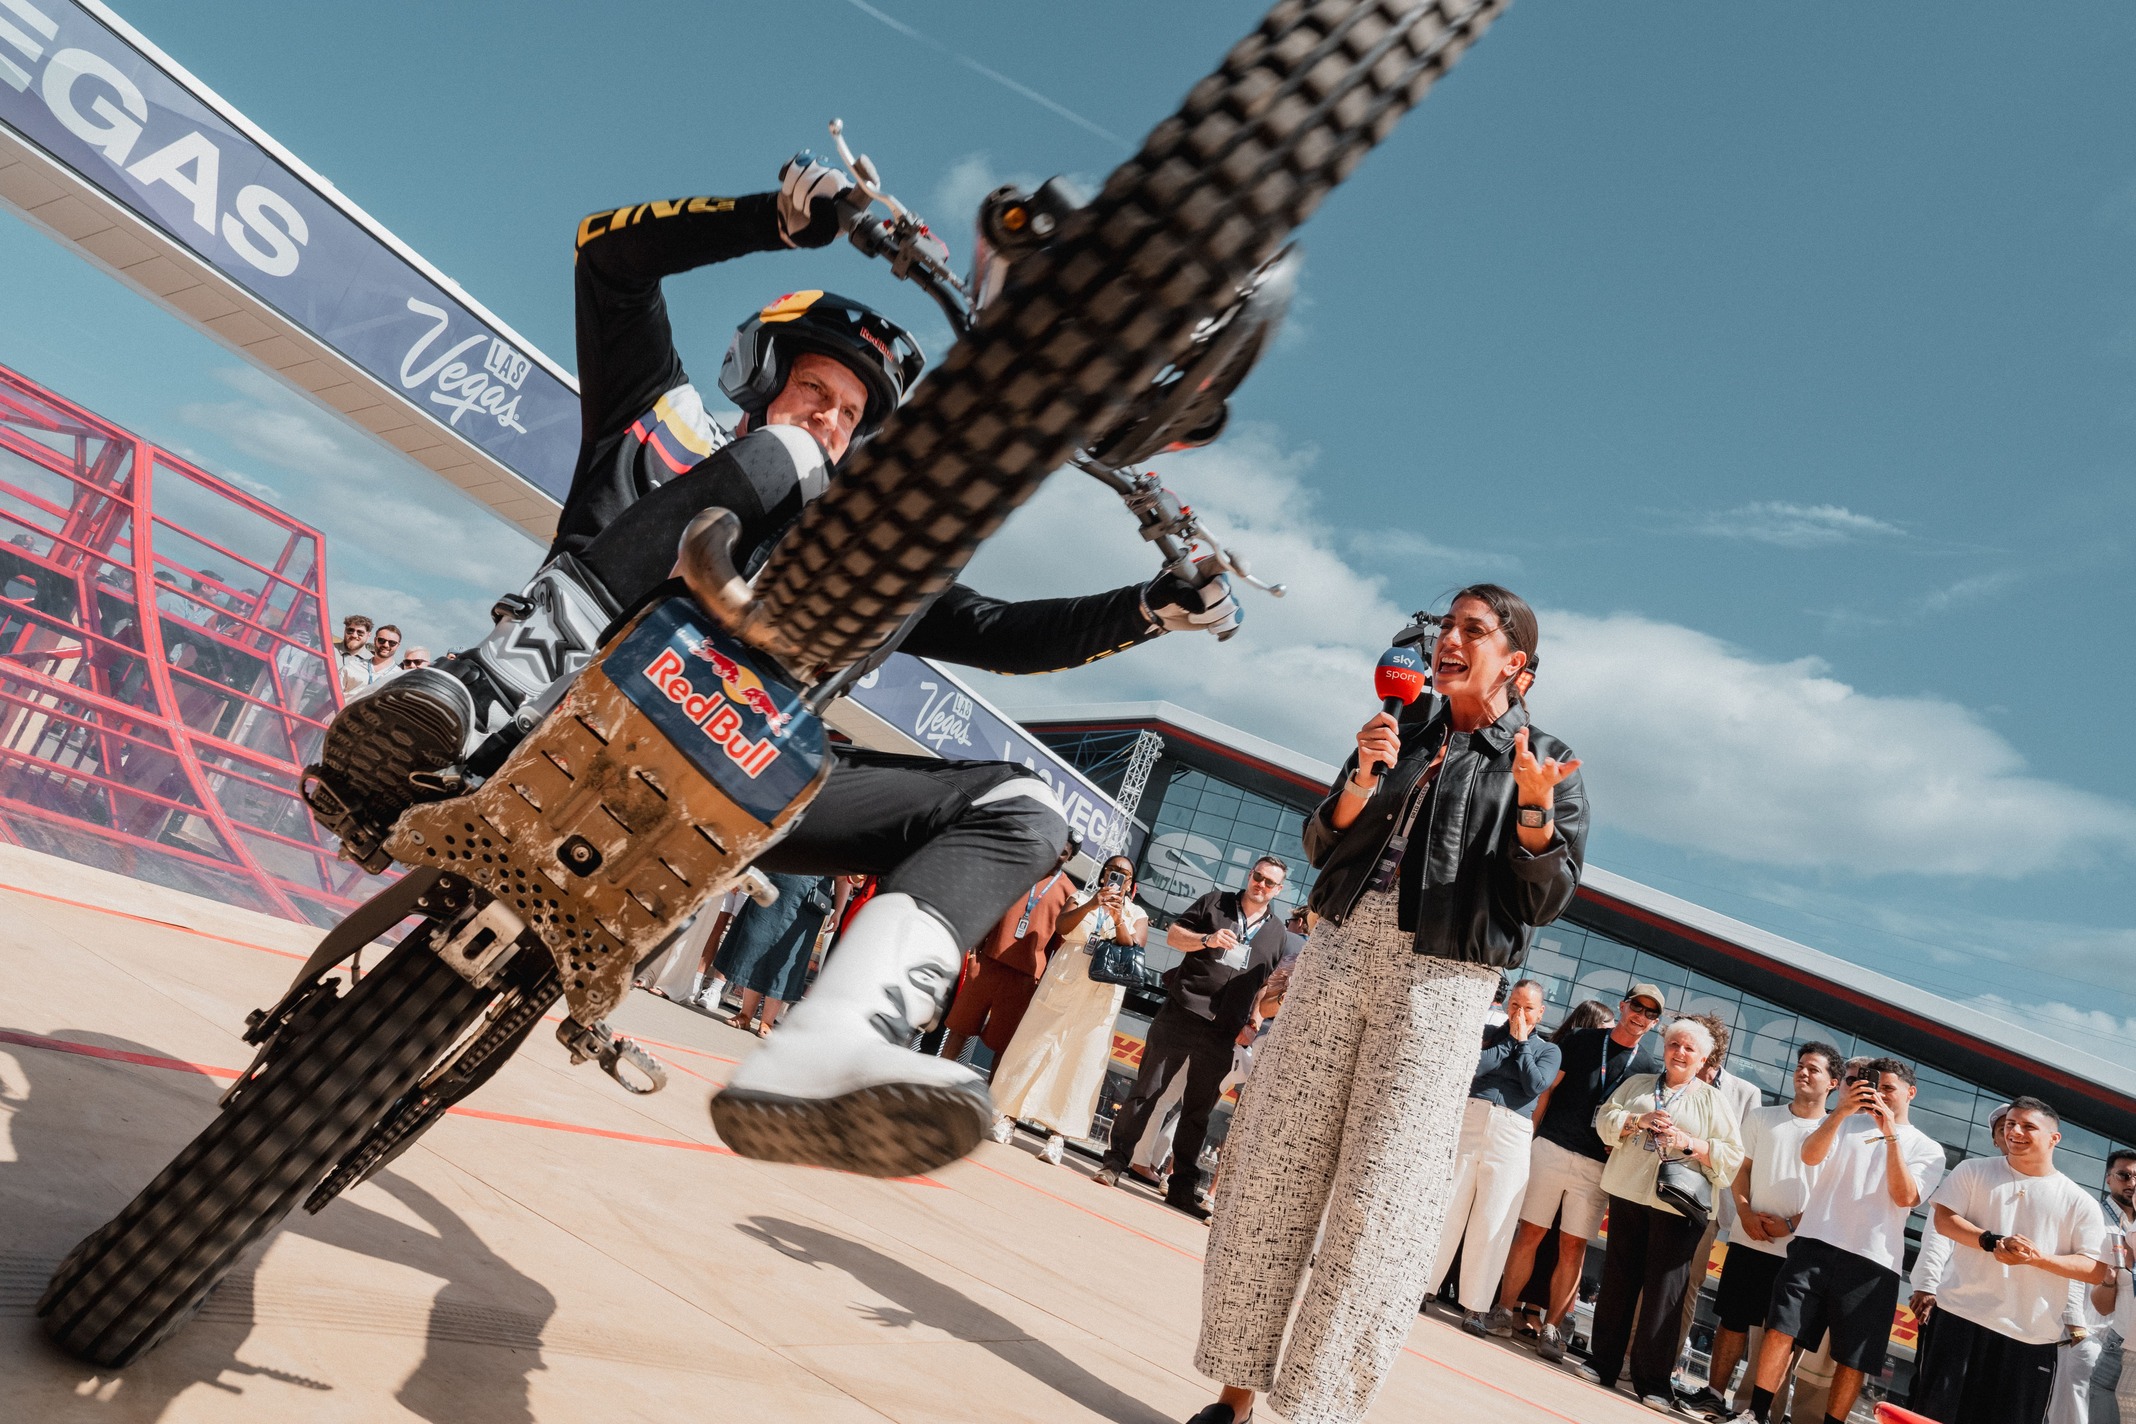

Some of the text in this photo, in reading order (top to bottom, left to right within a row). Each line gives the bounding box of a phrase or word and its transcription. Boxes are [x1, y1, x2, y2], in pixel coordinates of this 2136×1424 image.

[400, 297, 527, 434] Vegas
[488, 342, 529, 386] LAS
[1385, 670, 1417, 683] sport
[1393, 654, 1416, 668] sky
[644, 647, 780, 778] Red Bull
[915, 681, 973, 750] Vegas
